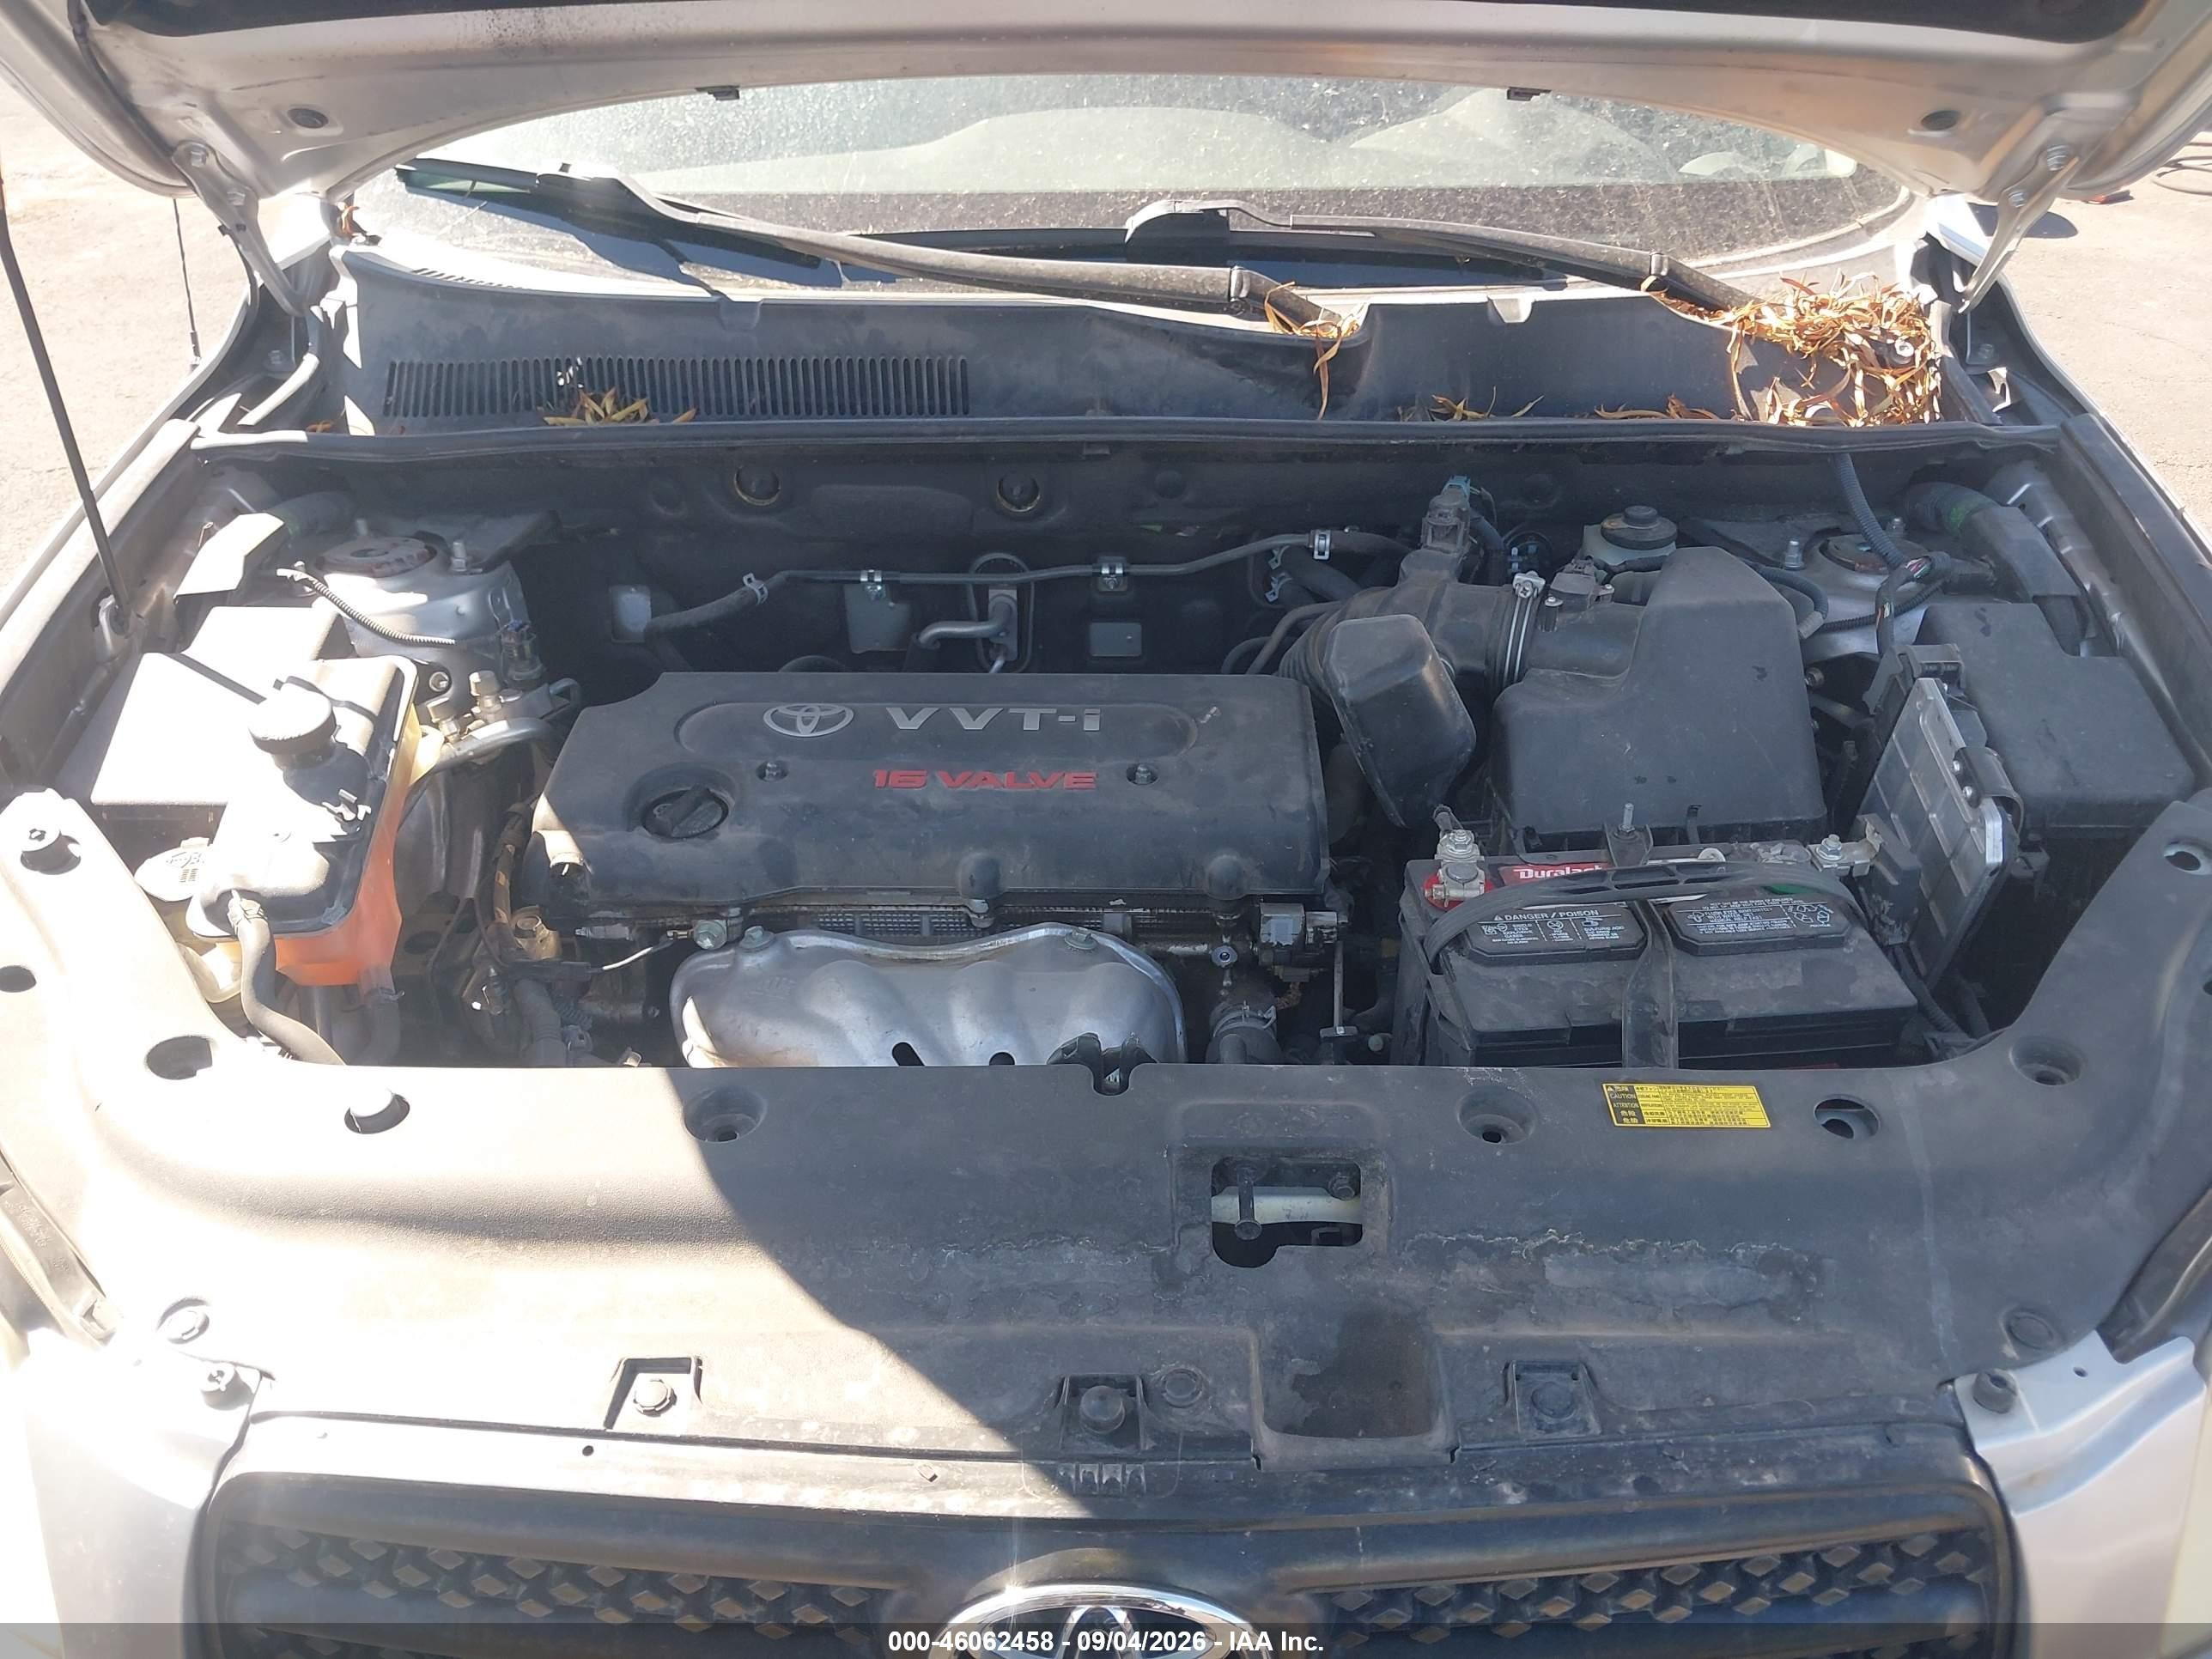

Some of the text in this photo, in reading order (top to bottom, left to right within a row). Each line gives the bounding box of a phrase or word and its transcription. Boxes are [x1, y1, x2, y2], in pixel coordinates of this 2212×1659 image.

[885, 706, 1101, 731] VVT-i
[873, 769, 1096, 789] 16 VALVE
[1559, 909, 1600, 918] POISON
